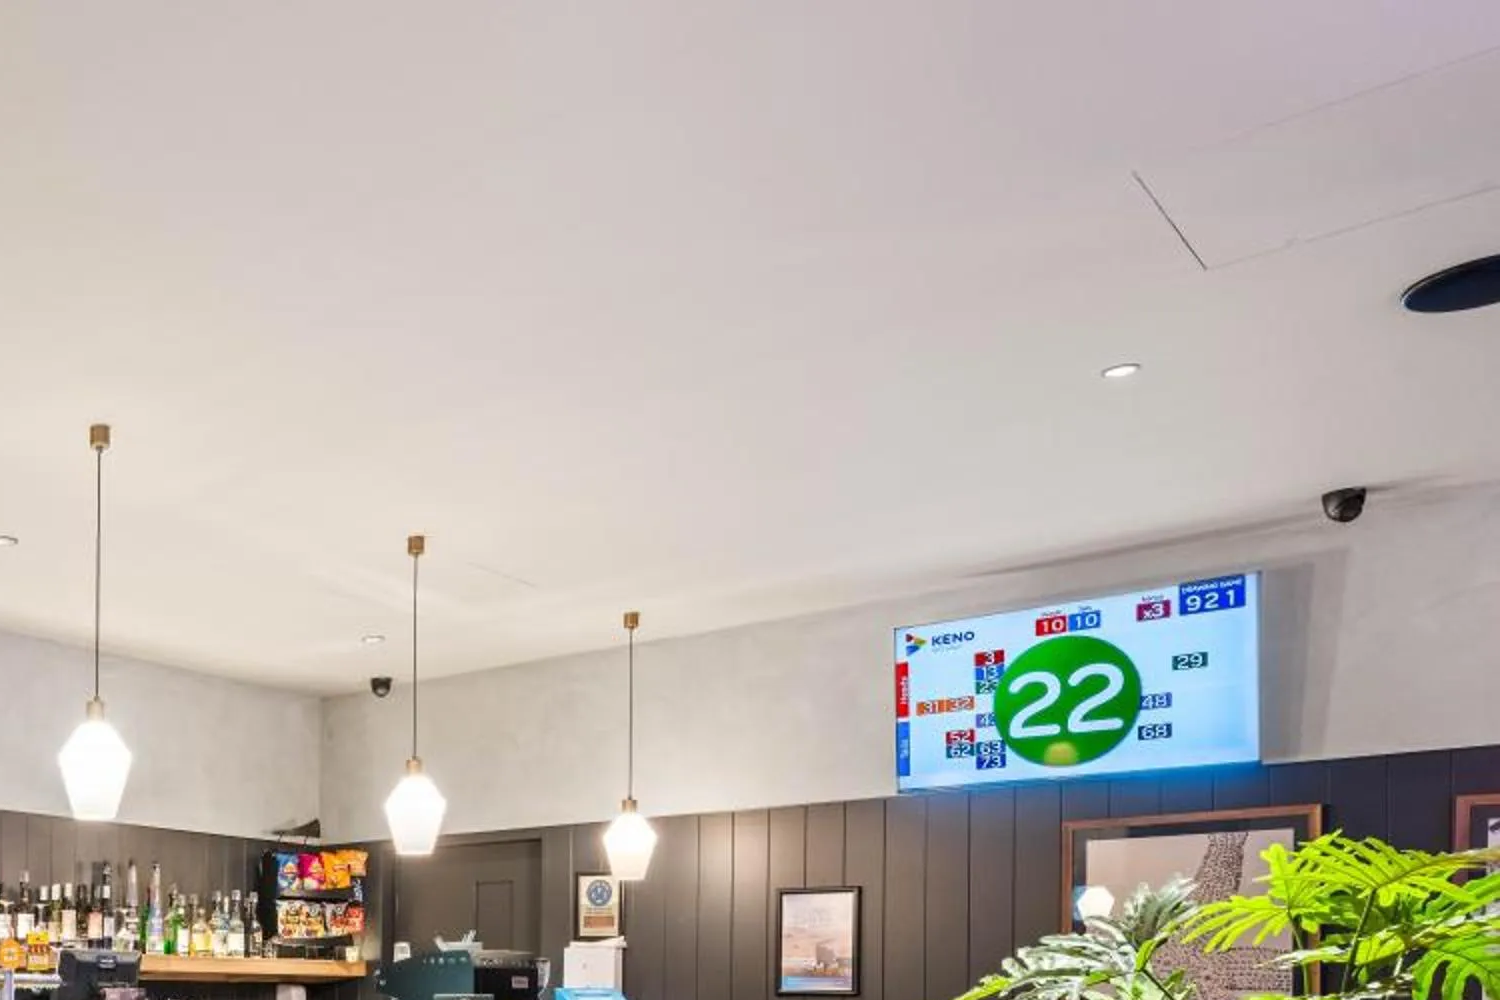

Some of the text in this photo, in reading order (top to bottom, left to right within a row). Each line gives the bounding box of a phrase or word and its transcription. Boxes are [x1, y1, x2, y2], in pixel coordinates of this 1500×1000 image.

[1186, 590, 1234, 611] 921
[1143, 603, 1164, 619] x3
[1043, 613, 1098, 633] 10 10
[931, 631, 975, 646] KENO
[984, 651, 995, 665] 3
[1177, 653, 1203, 669] 29
[924, 696, 973, 714] 31 32
[1008, 663, 1125, 740] 22
[1142, 723, 1167, 739] 68
[950, 743, 971, 757] 62
